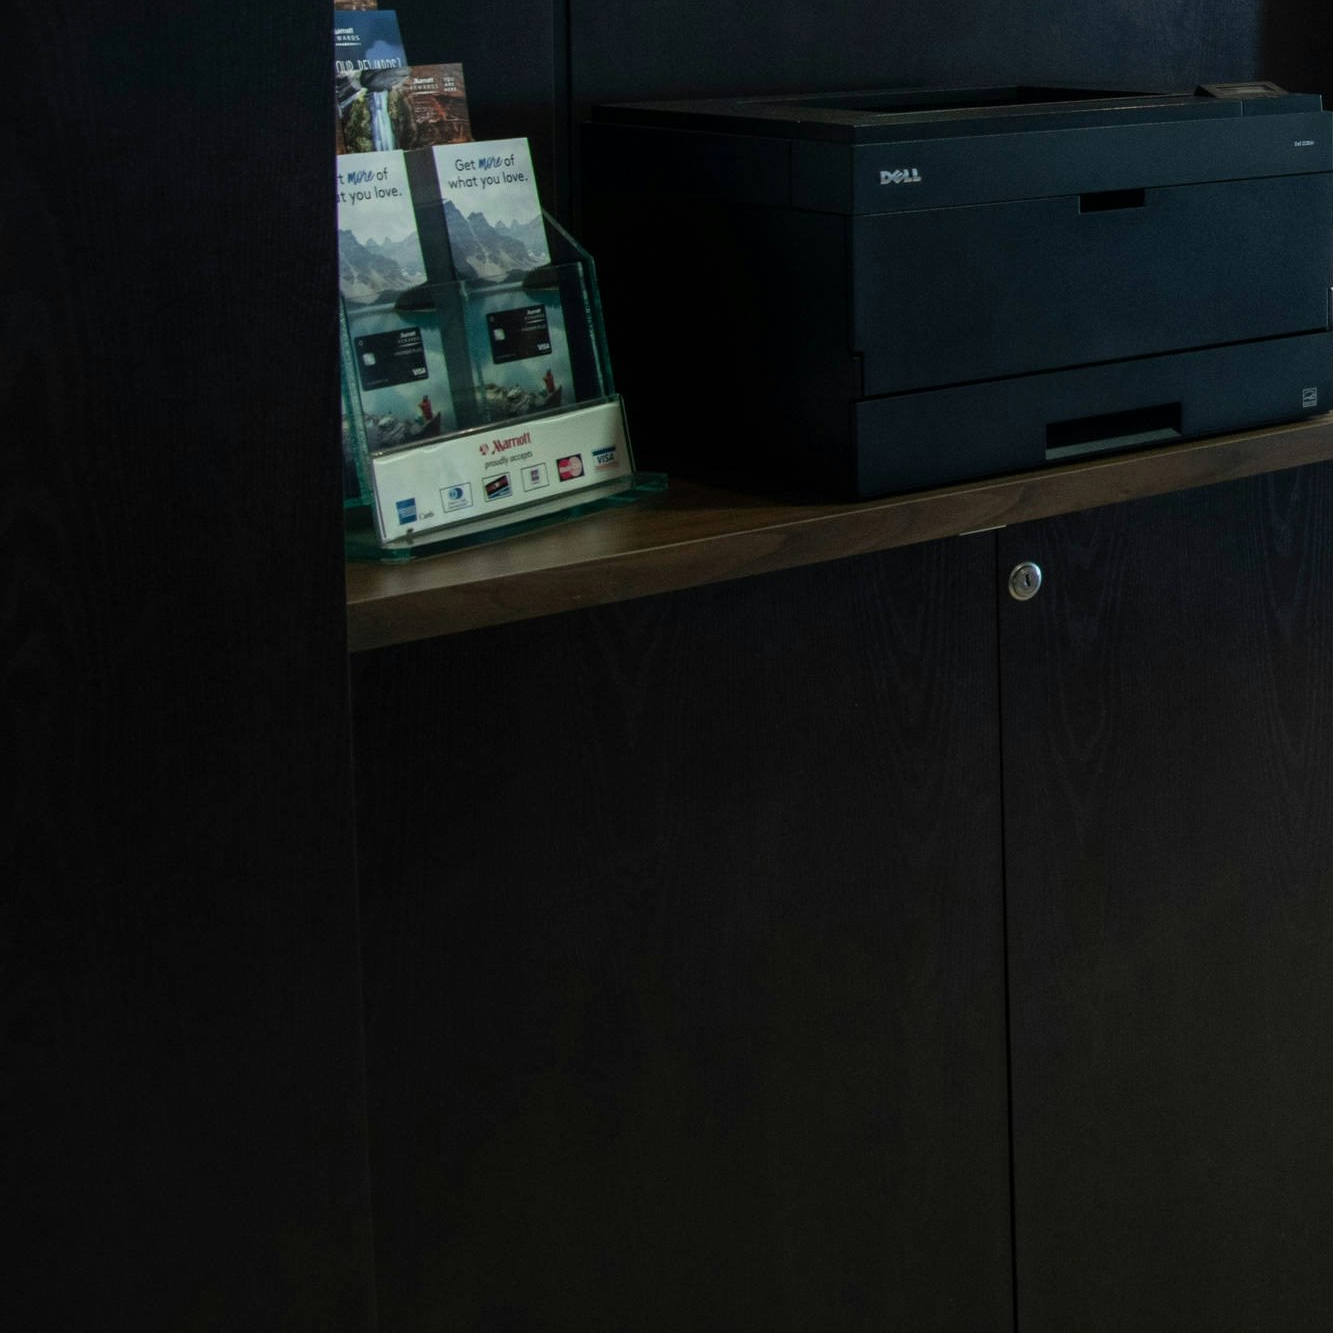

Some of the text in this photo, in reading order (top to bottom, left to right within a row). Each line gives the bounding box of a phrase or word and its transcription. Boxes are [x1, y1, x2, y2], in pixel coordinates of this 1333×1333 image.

[455, 154, 515, 172] Get more of
[347, 167, 375, 185] more
[376, 167, 389, 181] of
[448, 171, 529, 189] what you love.
[880, 168, 922, 185] DELL
[349, 188, 372, 205] you
[374, 185, 403, 199] love.
[491, 431, 533, 455] Marriott
[596, 451, 615, 464] VISA
